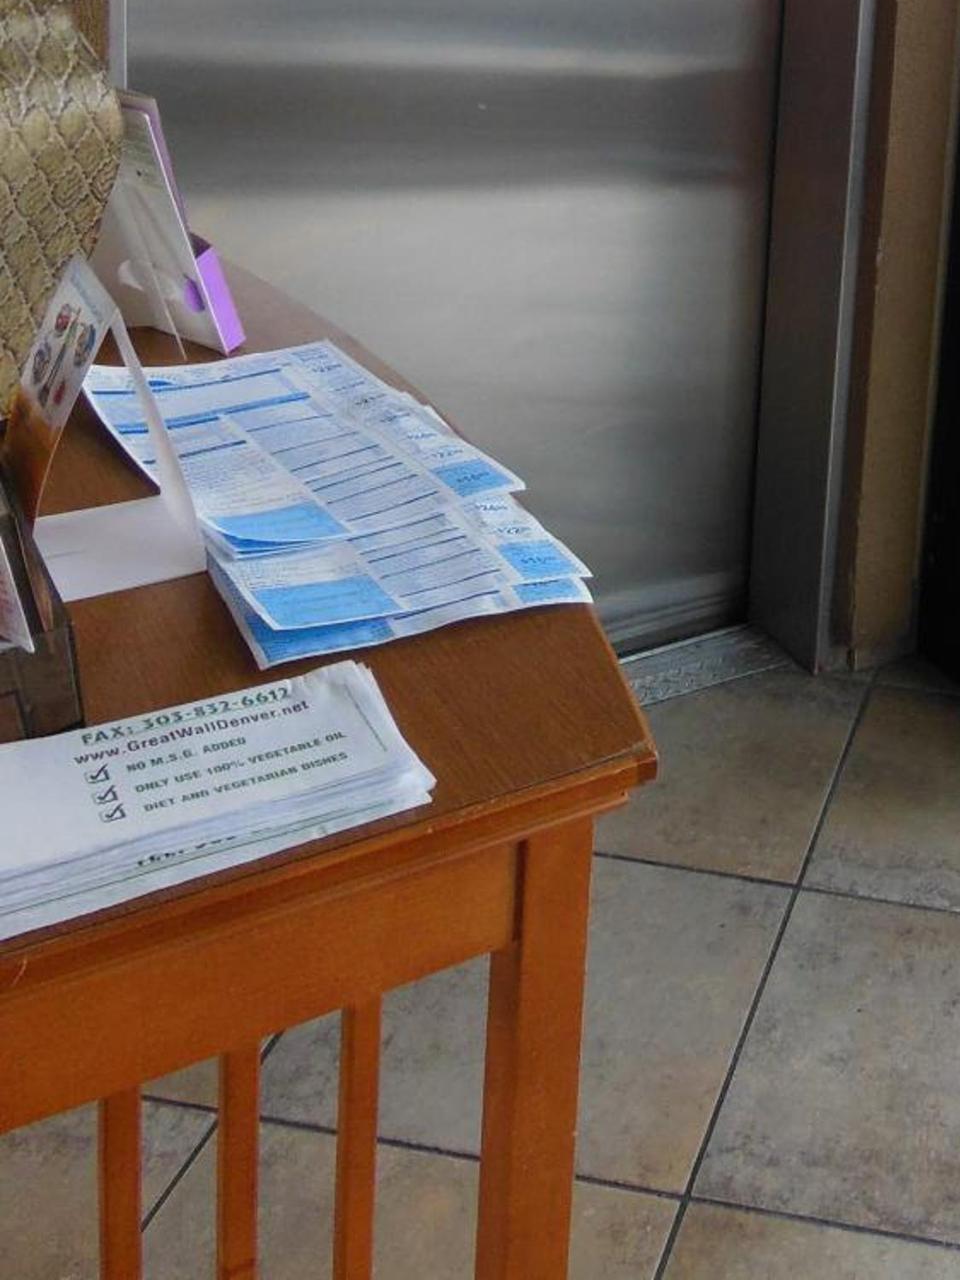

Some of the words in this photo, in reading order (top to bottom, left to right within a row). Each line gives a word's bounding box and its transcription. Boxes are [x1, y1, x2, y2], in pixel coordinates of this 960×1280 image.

[74, 699, 310, 765] www.GreatWallDenver.net
[81, 723, 134, 746] FAX:
[143, 686, 291, 731] 303-832-6612
[126, 760, 147, 774] NO
[202, 736, 247, 756] ADDED
[135, 777, 169, 794] ONLY
[174, 770, 203, 785] USE
[206, 759, 246, 777] 100%
[247, 738, 321, 766] VEGETABLE
[324, 730, 348, 744] OIL
[143, 798, 177, 813] DIET
[181, 789, 210, 803] AND
[213, 766, 299, 795] VEGETARIAN
[301, 751, 349, 773] DISHES
